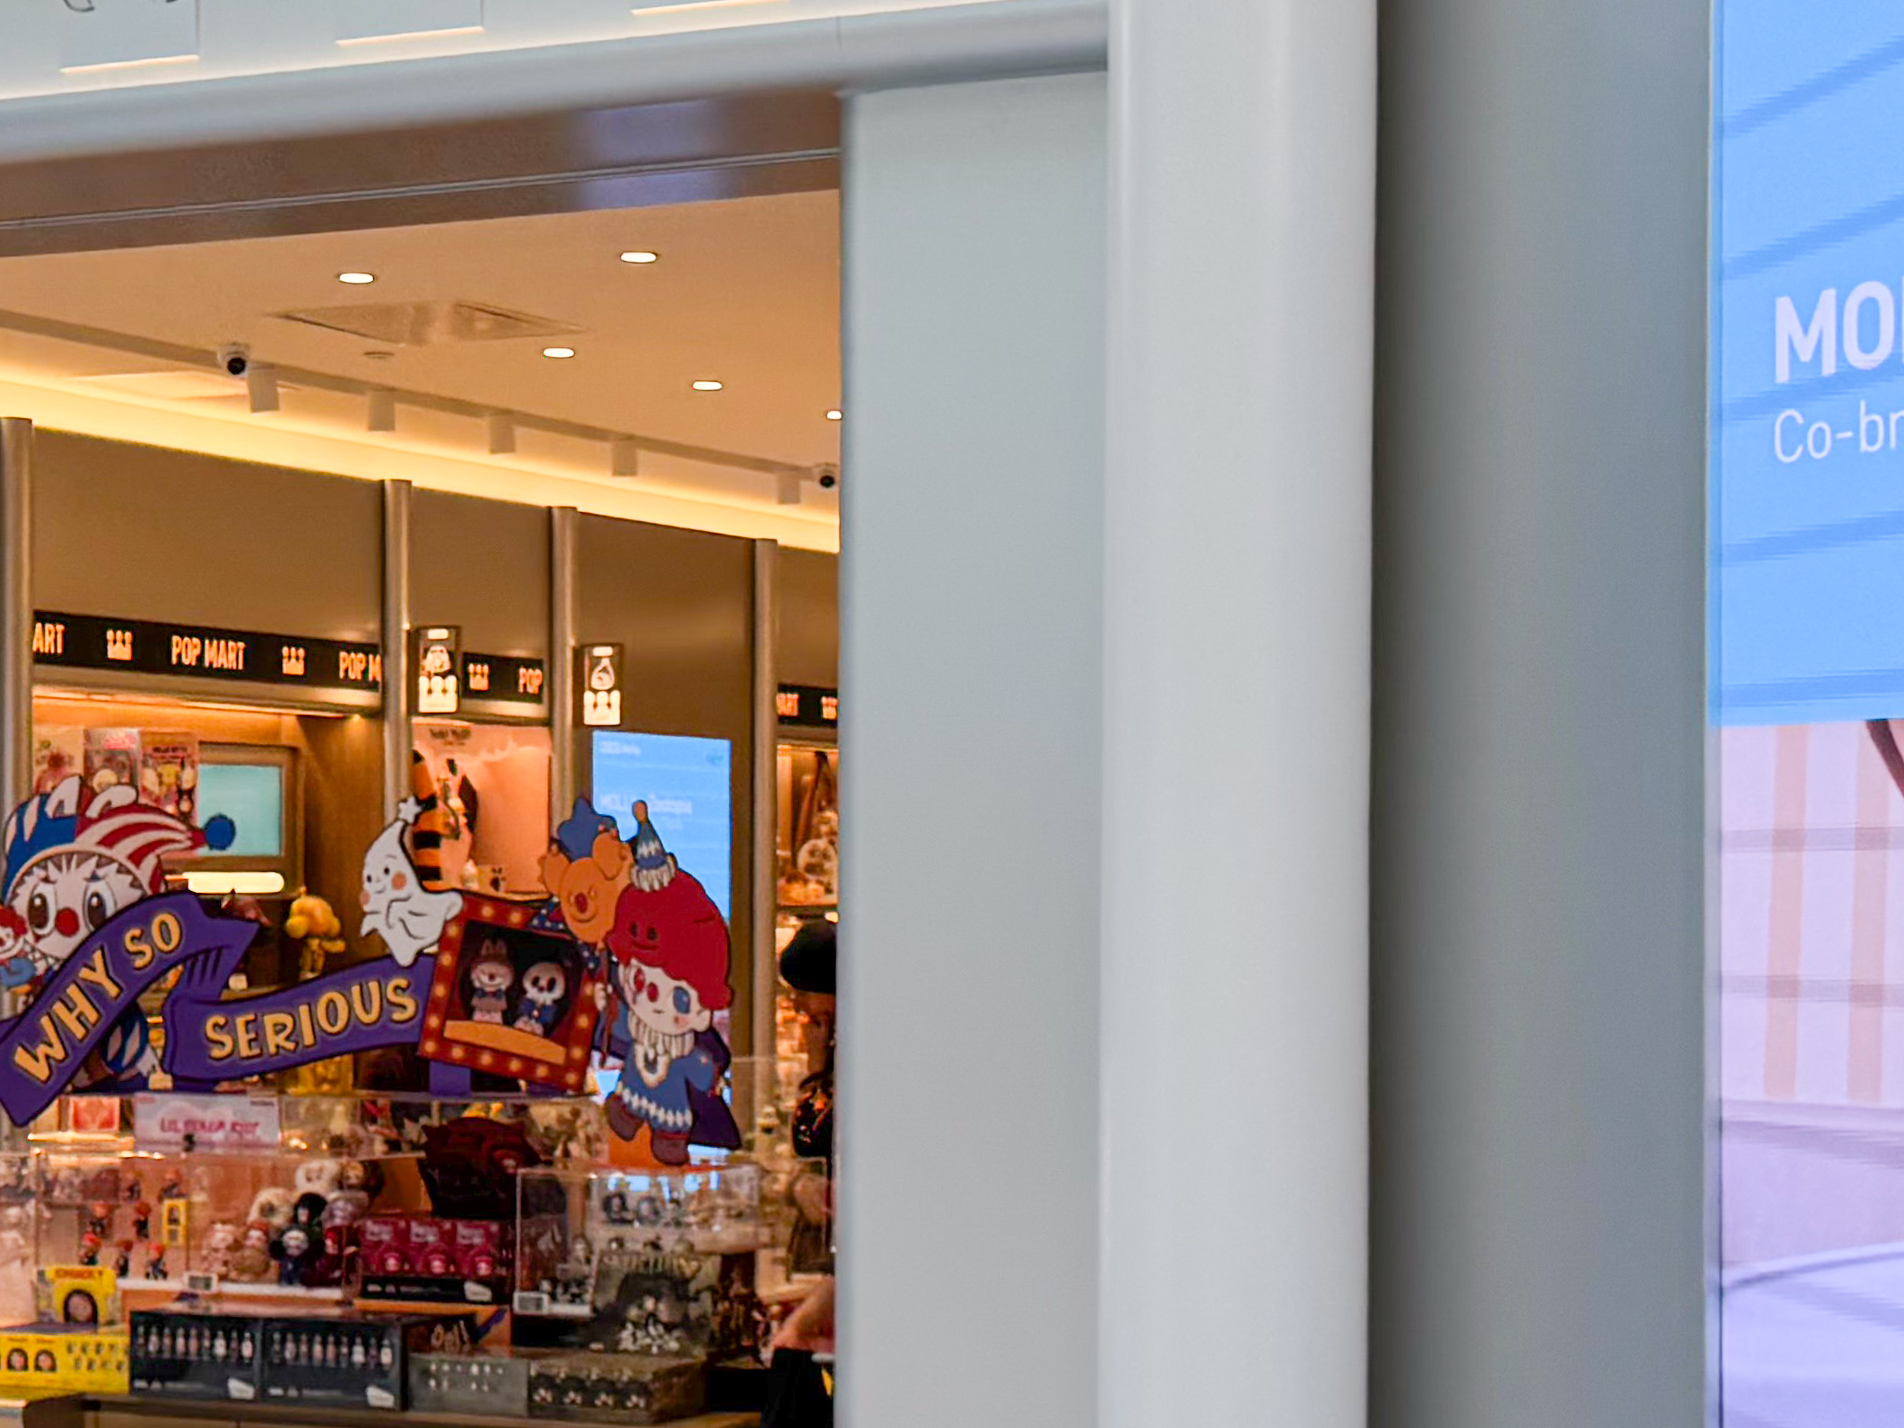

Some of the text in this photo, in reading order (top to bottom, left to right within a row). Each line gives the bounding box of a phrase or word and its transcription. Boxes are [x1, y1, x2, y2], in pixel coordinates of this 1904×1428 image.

[171, 635, 202, 666] POP
[204, 639, 246, 671] MART
[338, 651, 367, 680] POP
[13, 911, 184, 1087] WHY SO
[204, 977, 418, 1062] SERIOUS
